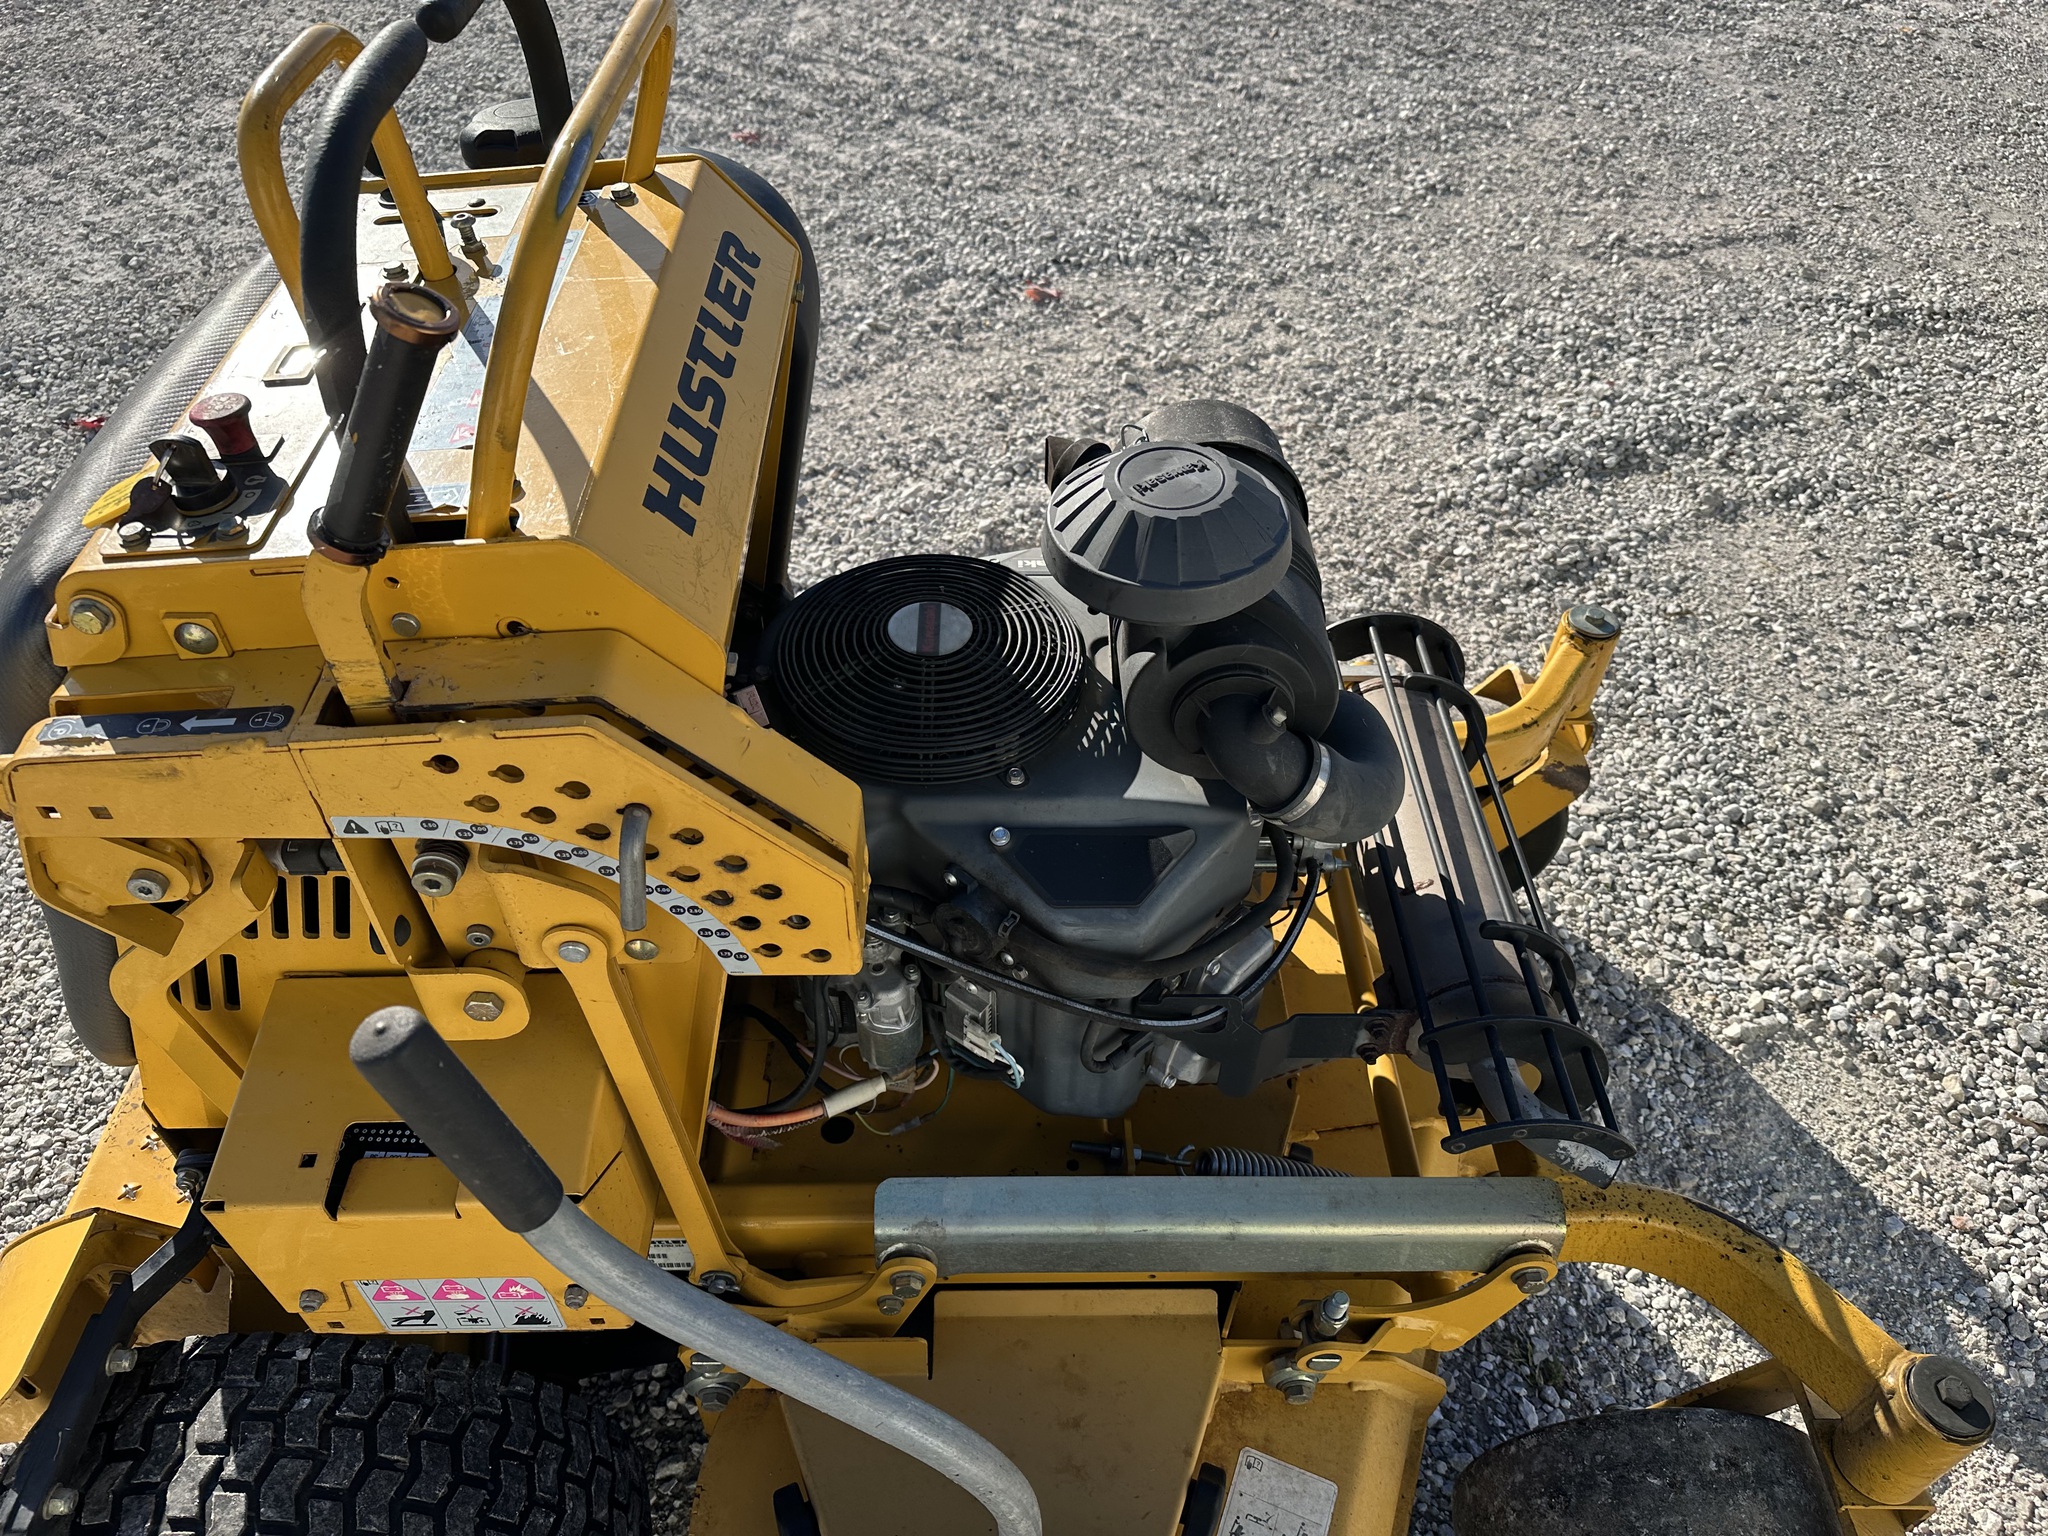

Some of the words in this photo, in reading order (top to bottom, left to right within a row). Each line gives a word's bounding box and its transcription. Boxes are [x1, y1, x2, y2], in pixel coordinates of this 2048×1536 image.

[642, 230, 761, 537] HUSTLER
[1132, 460, 1210, 496] Kawasaki
[471, 825, 487, 833] 5.00
[507, 839, 523, 847] 4.75
[523, 835, 538, 843] 4.50
